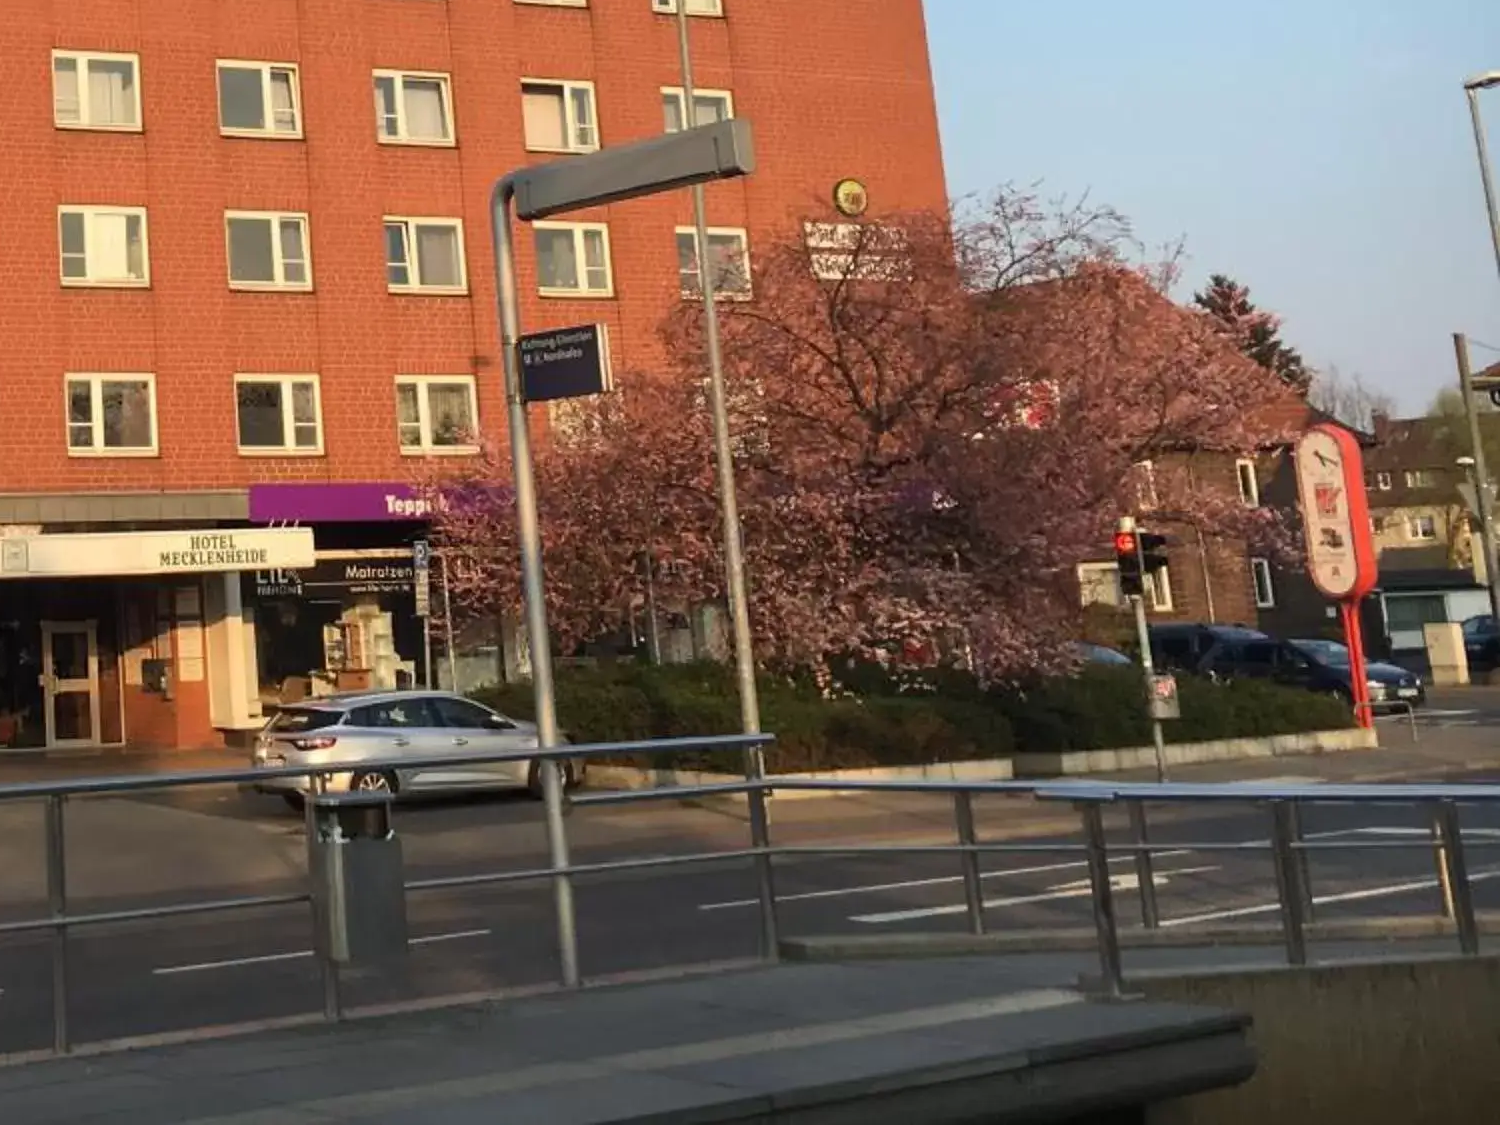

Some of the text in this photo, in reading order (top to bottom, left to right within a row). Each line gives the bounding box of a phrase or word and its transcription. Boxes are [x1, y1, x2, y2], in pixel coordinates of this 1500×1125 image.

[189, 535, 237, 550] HOTEL
[158, 549, 268, 567] MECKLENHEIDE
[345, 564, 413, 580] Matratzen
